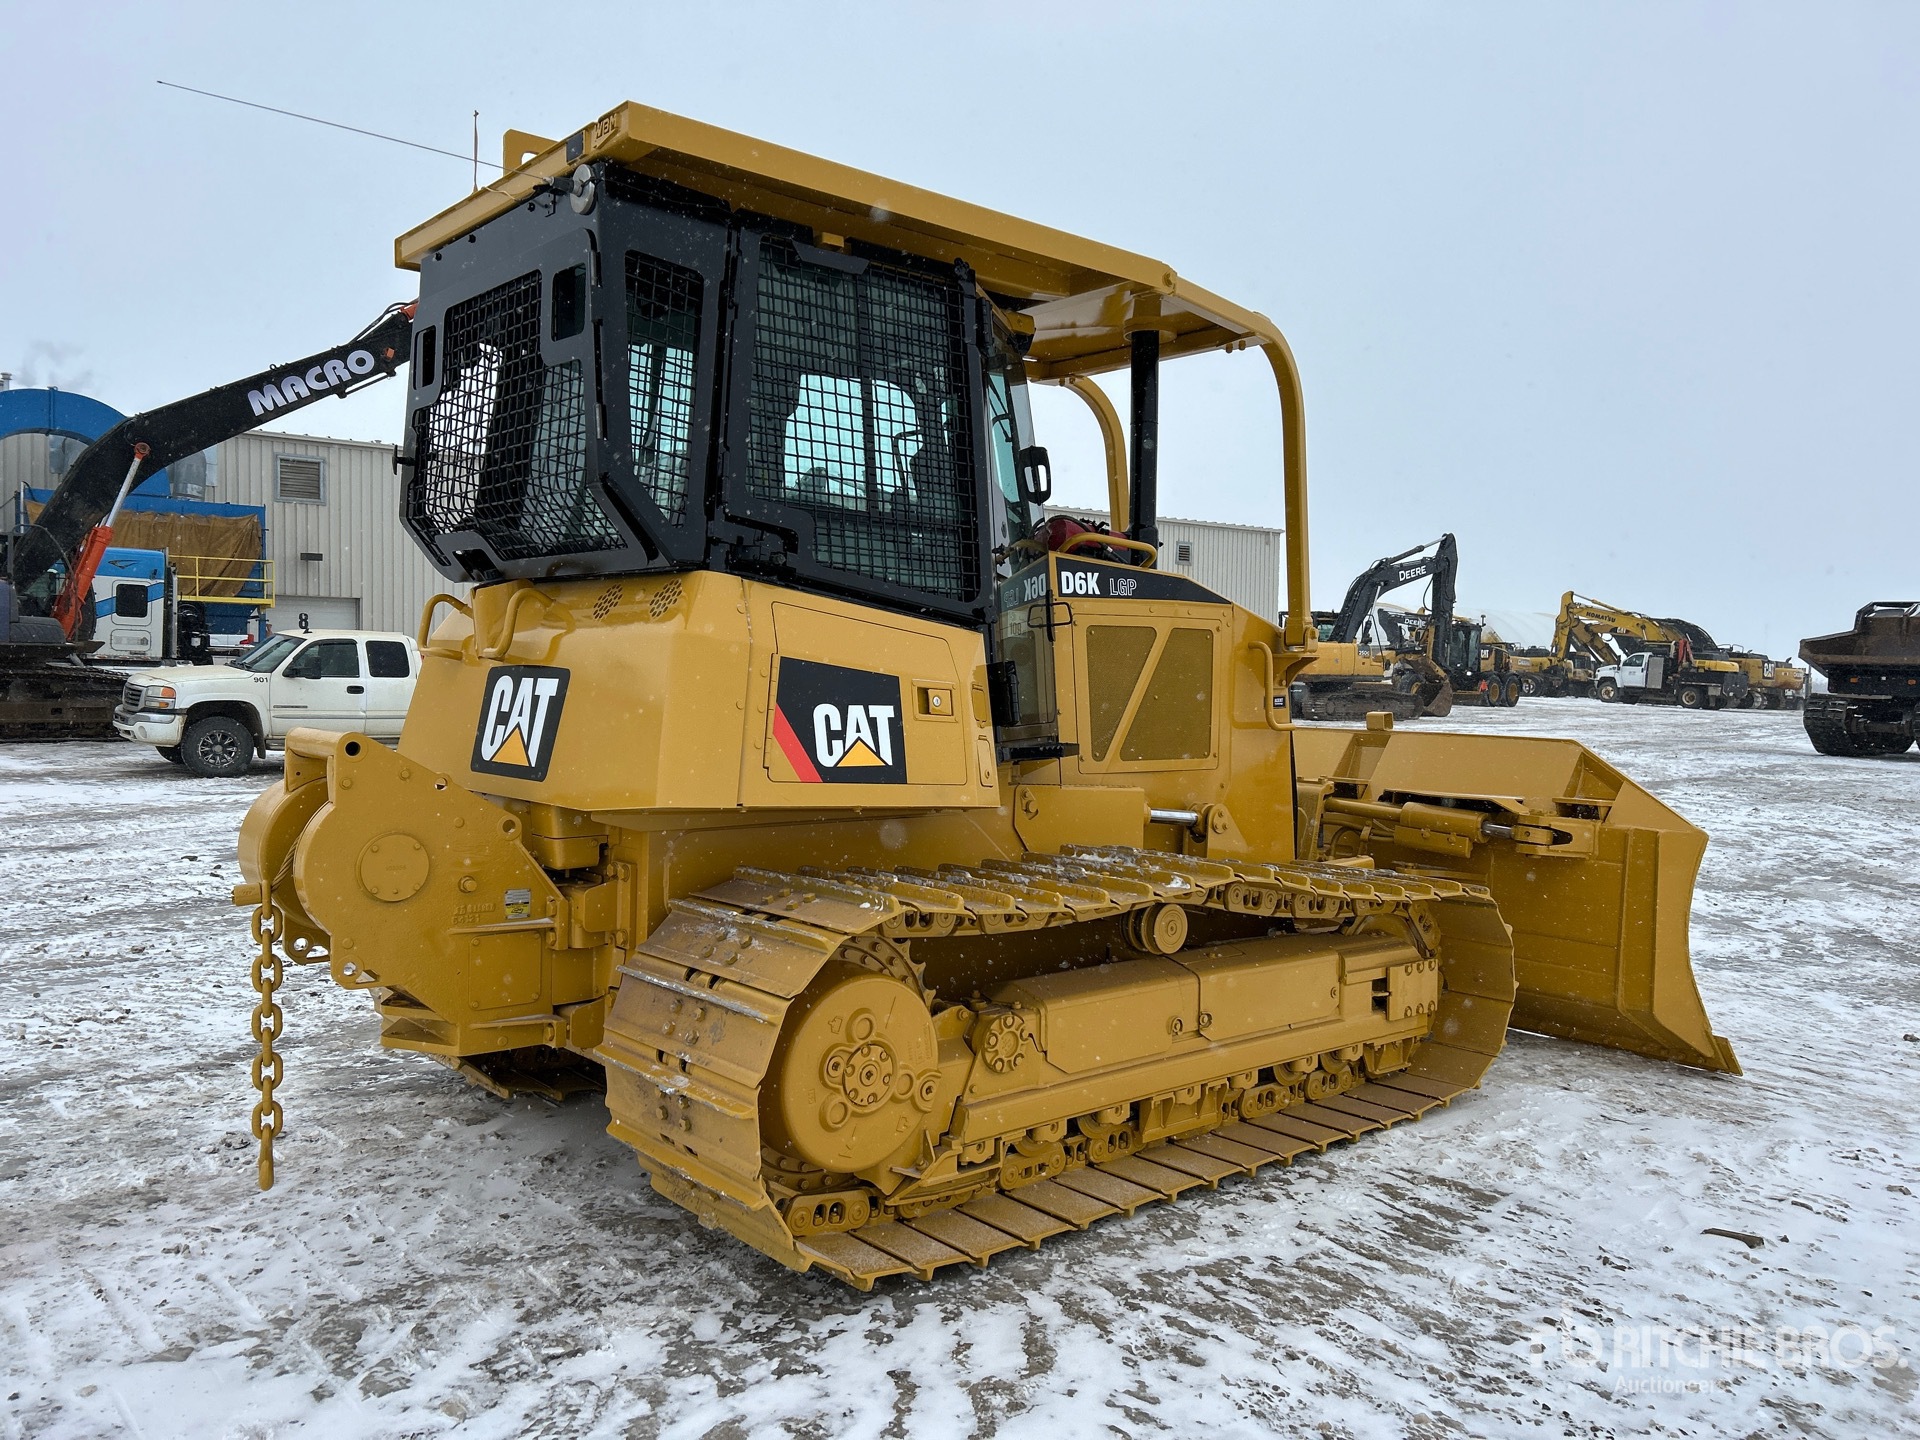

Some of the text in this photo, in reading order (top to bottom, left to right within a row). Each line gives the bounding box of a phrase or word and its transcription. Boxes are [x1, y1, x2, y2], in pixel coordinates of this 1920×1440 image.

[247, 349, 375, 417] MACRO
[1398, 565, 1427, 581] DEERE
[1060, 571, 1137, 596] D6K LGP
[298, 612, 309, 629] 8
[1586, 611, 1616, 623] KOMATSU
[1480, 649, 1489, 658] CAT
[1763, 662, 1775, 678] CAT
[481, 675, 560, 768] CAT
[813, 703, 895, 768] CAT
